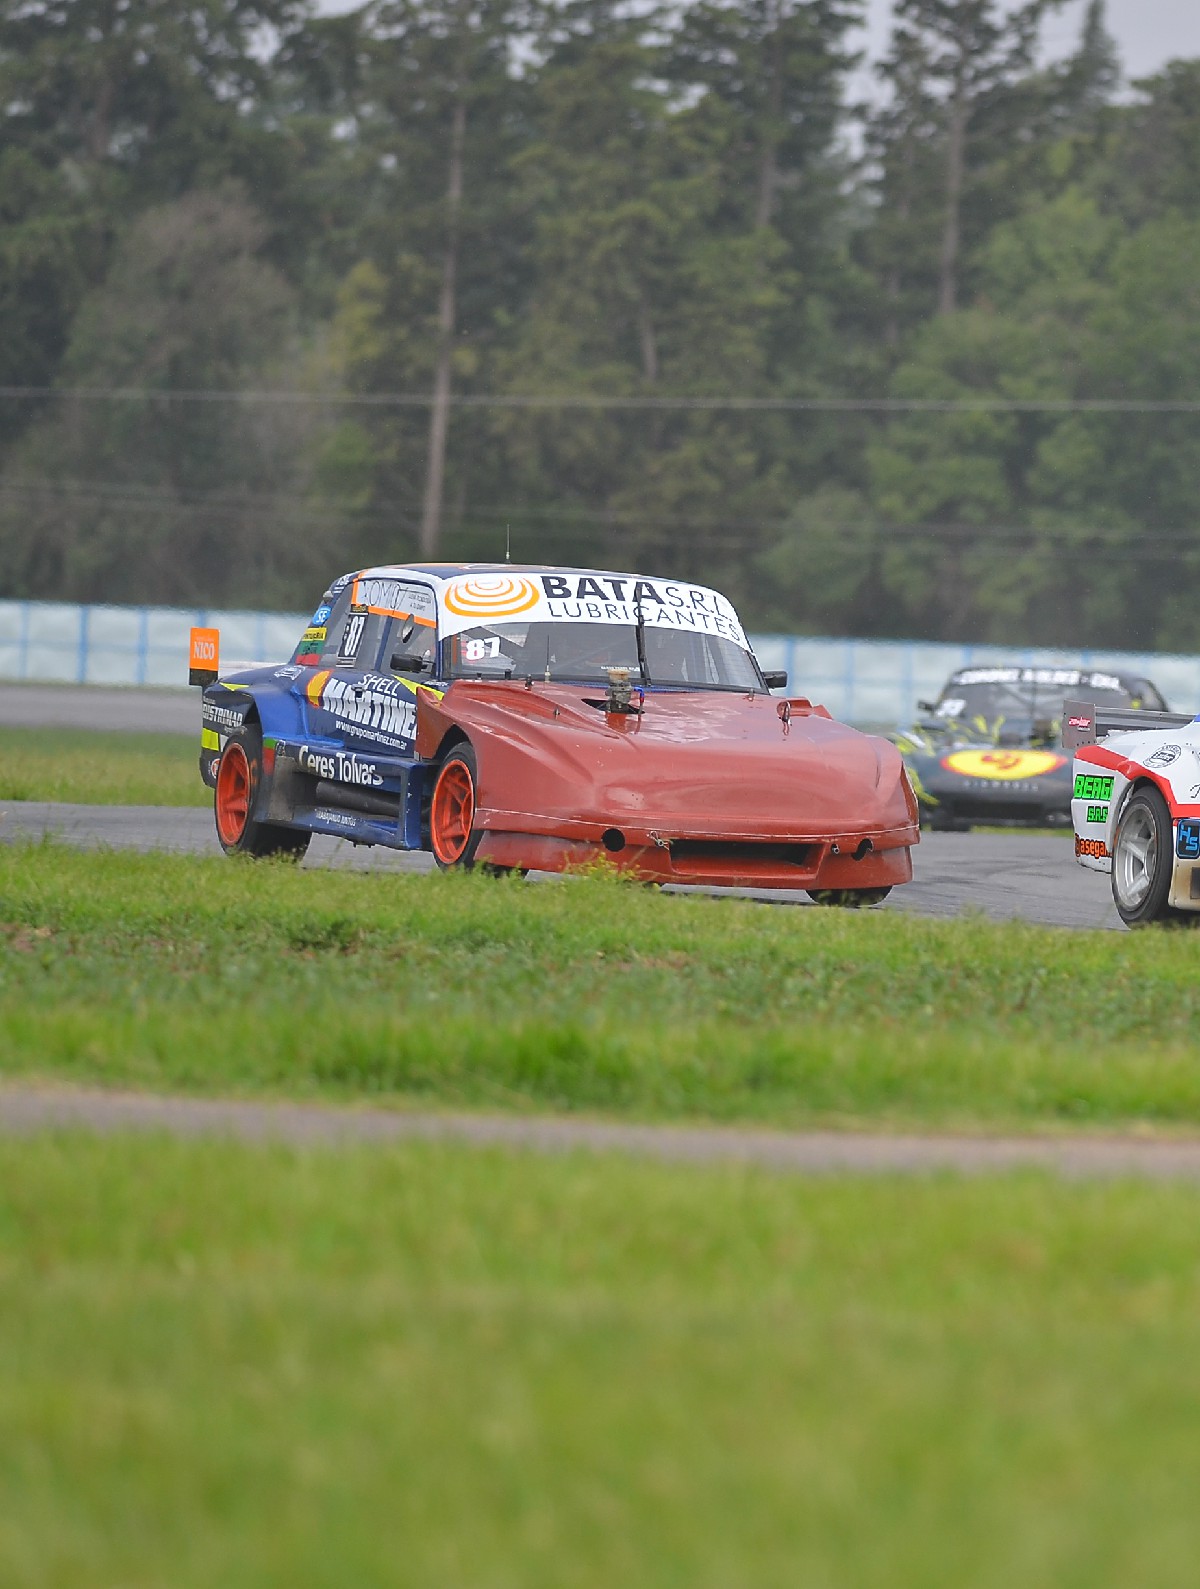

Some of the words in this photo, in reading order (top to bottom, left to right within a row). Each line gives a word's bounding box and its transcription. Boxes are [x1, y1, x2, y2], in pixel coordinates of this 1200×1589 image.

[540, 575, 666, 605] BATA
[547, 601, 741, 642] LUBRICANTES
[193, 641, 215, 660] NICO
[466, 636, 500, 660] 87
[358, 674, 401, 697] SHELL
[322, 678, 418, 740] MARTINE
[335, 720, 408, 751] www.grupomartinez.com.ar
[298, 745, 335, 780] Ceres
[336, 752, 384, 786] Tolvas
